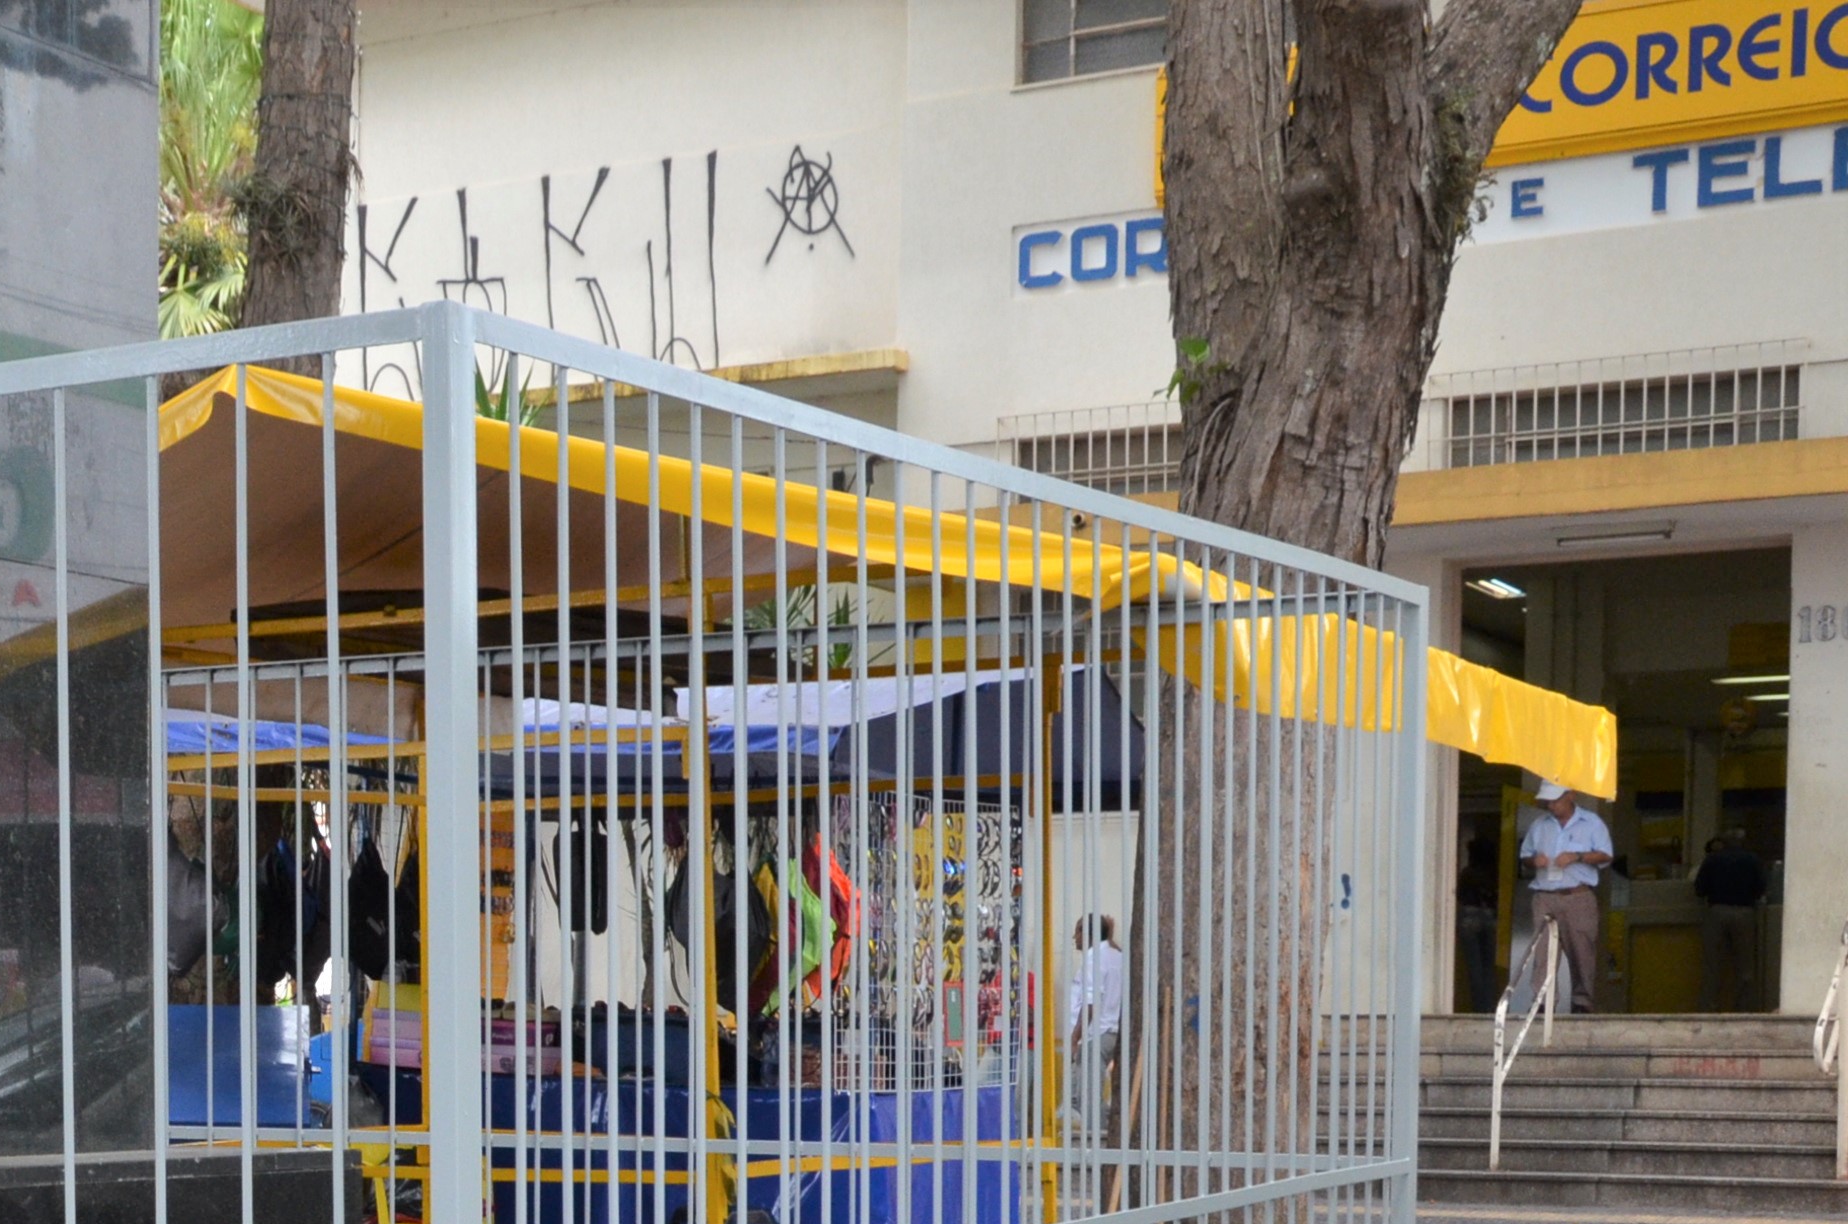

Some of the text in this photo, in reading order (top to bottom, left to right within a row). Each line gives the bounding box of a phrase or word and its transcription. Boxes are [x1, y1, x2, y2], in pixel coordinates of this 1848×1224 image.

[1019, 126, 1848, 288] COR E TEL
